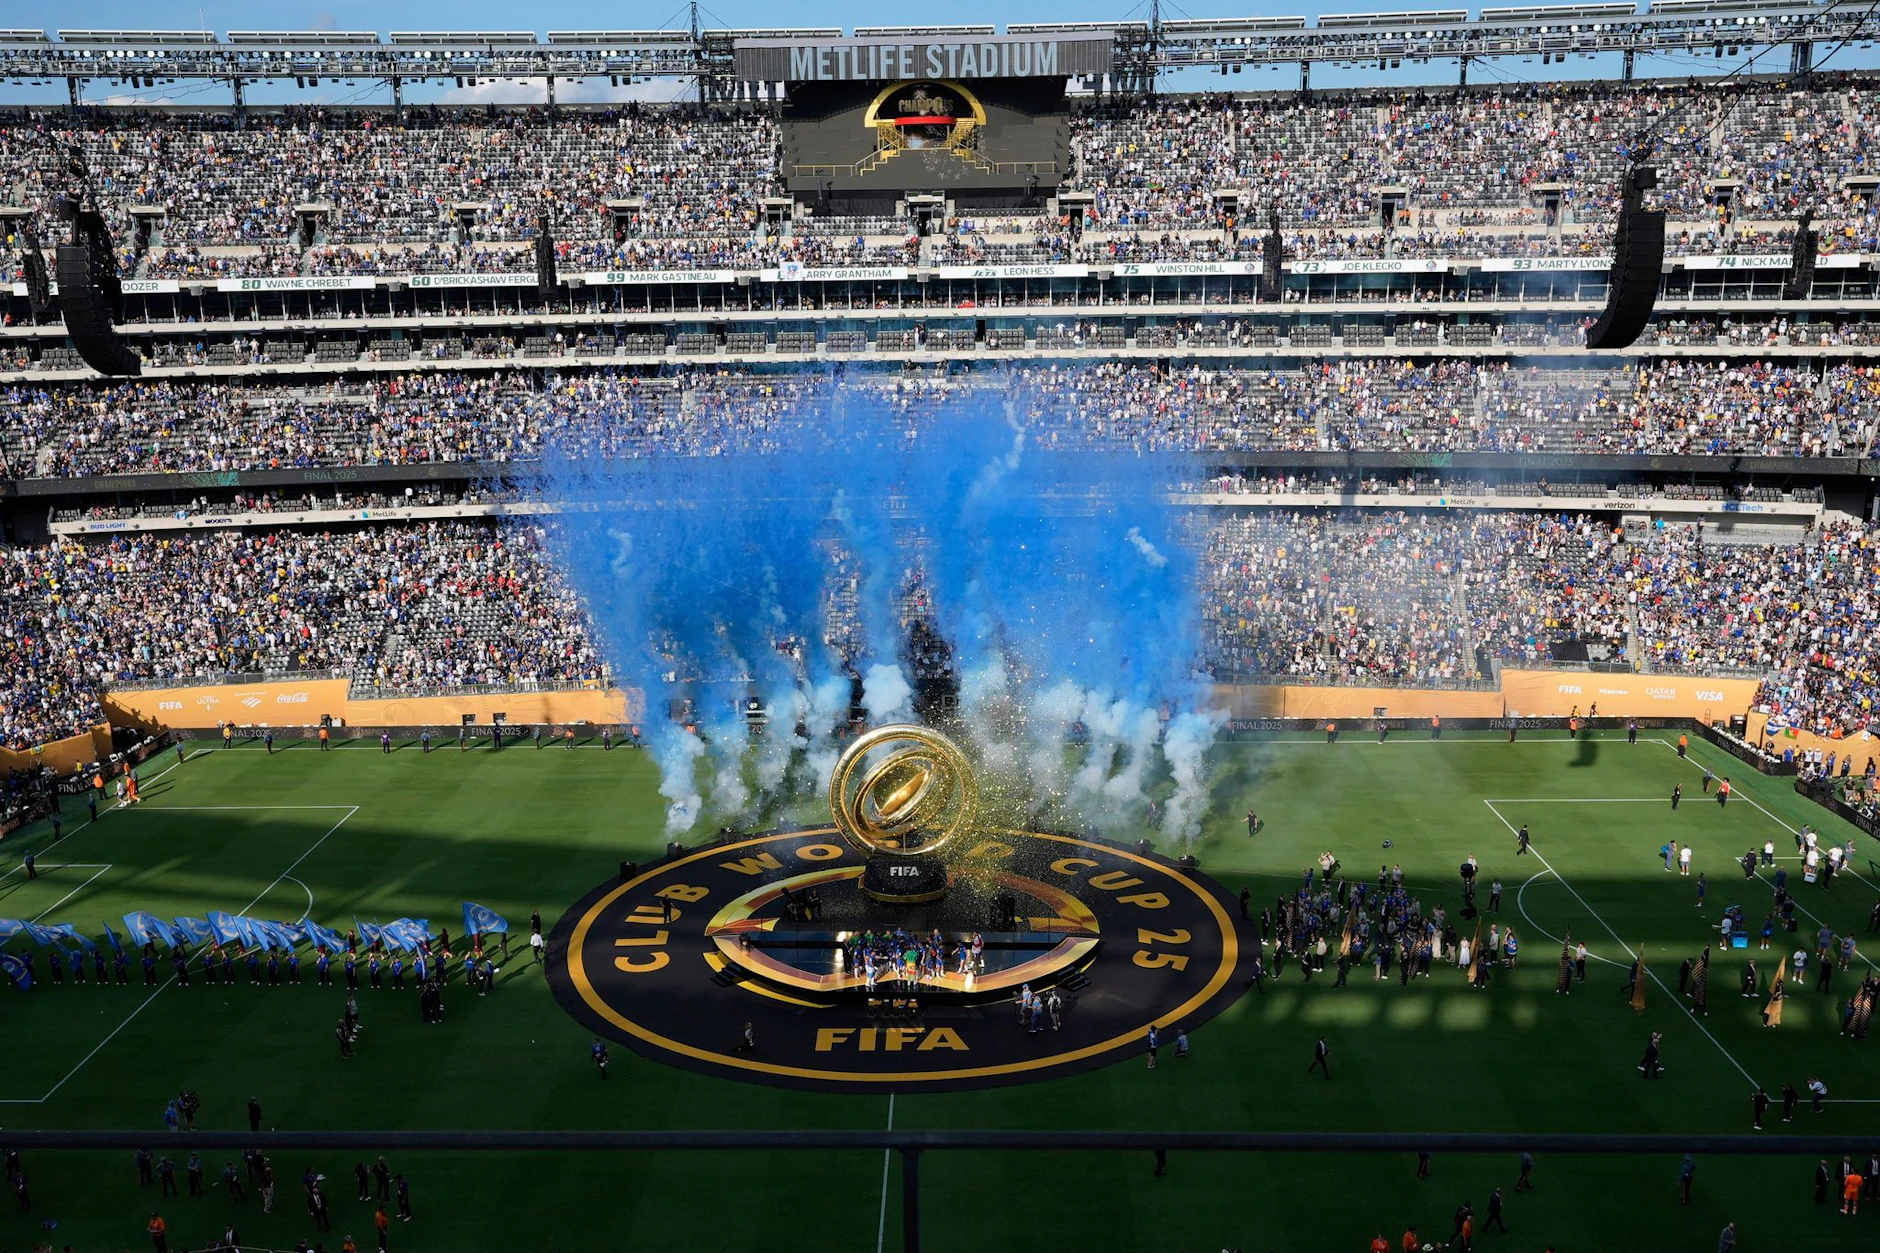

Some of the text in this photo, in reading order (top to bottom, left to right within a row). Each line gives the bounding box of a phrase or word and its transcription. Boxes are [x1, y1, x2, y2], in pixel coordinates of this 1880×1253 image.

[790, 42, 1058, 80] METLIFE STADIUM
[1512, 260, 1532, 270] 93
[1538, 260, 1578, 269] MARTY
[1716, 256, 1736, 267] 74
[1742, 257, 1766, 266] NICK
[1123, 264, 1224, 274] 75 WINSTON HILL
[1302, 261, 1402, 272] 73 JOE KLECKO
[835, 270, 892, 278] GRANTHAM
[1004, 268, 1028, 276] LEON
[1031, 267, 1054, 275] HESS
[412, 275, 538, 286] 60 D'BRICKASHAW FERGU
[607, 272, 716, 282] 99 MARK GASTINEAU
[122, 282, 158, 291] OOZER
[242, 279, 352, 289] 80 WAYNE CHREBET
[1519, 457, 1574, 466] FINAL 2025
[335, 471, 357, 479] 2025
[95, 478, 136, 489] CHAMPIONS
[1722, 503, 1763, 511] HCLTech
[1558, 685, 1581, 694] FIFA
[1696, 691, 1723, 702] VISA
[159, 701, 183, 710] FIFA
[1490, 719, 1540, 728] FINA 2025
[231, 729, 250, 737] NAL
[500, 727, 521, 735] 2025
[890, 867, 919, 876] FIFA
[614, 841, 1192, 972] CLUB WOD CUP 25
[815, 1027, 970, 1051] FIFA
